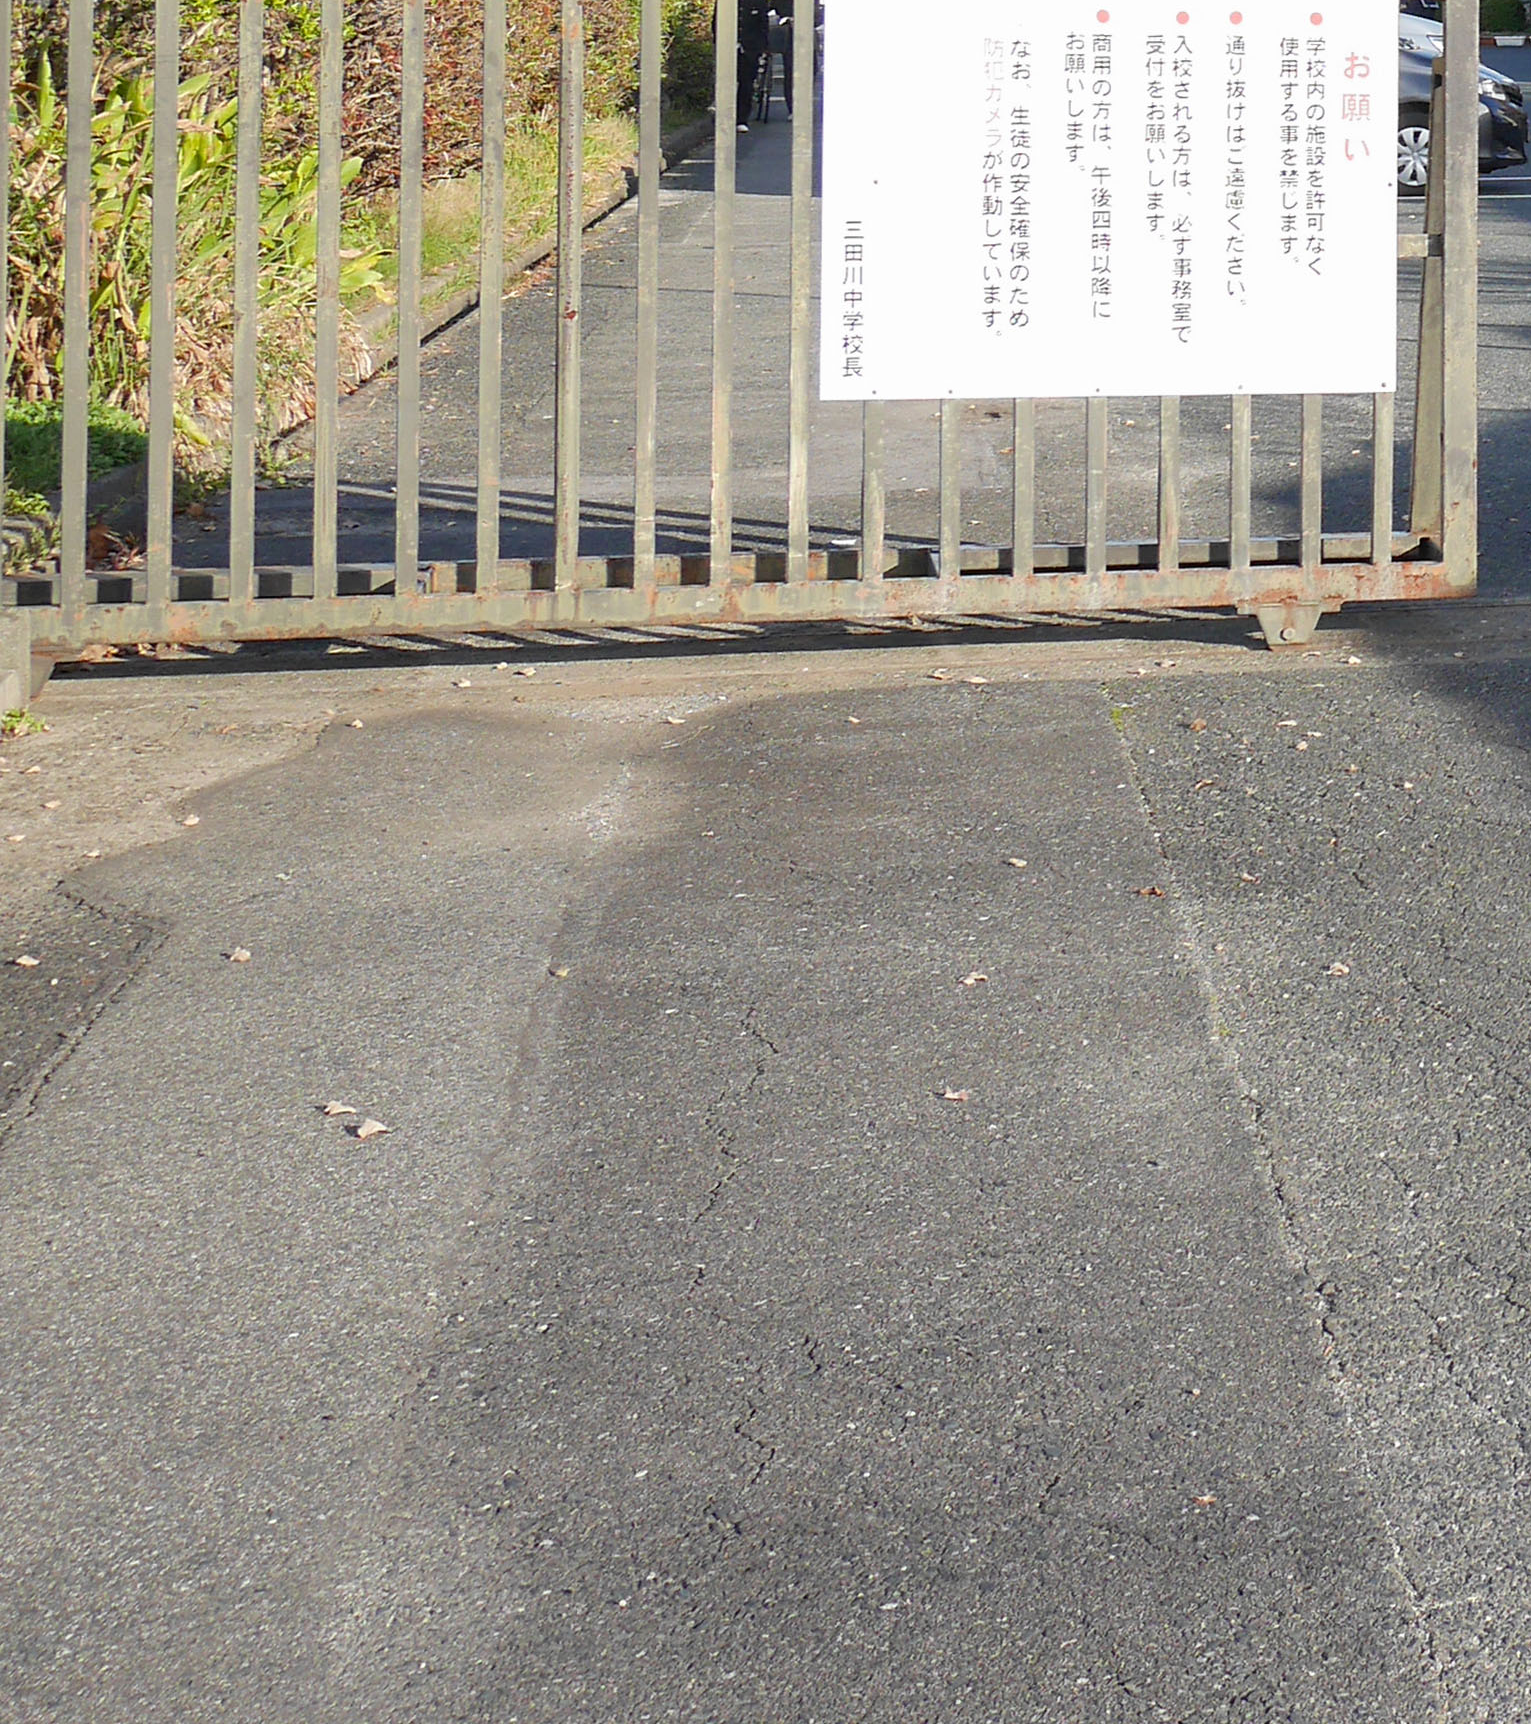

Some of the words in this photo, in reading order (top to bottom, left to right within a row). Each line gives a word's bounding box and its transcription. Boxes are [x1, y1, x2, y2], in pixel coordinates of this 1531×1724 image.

[1064, 31, 1086, 171] お願いします。
[1145, 34, 1166, 241] 受付をお願いします。
[1225, 35, 1247, 306] 通り抜けはご遠慮ください。
[1279, 37, 1300, 264] 使用する事を禁じます。
[1306, 37, 1326, 276] 学校内の施設を許可なく
[1342, 52, 1371, 161] お願い
[842, 220, 864, 377] 三田川中学校長
